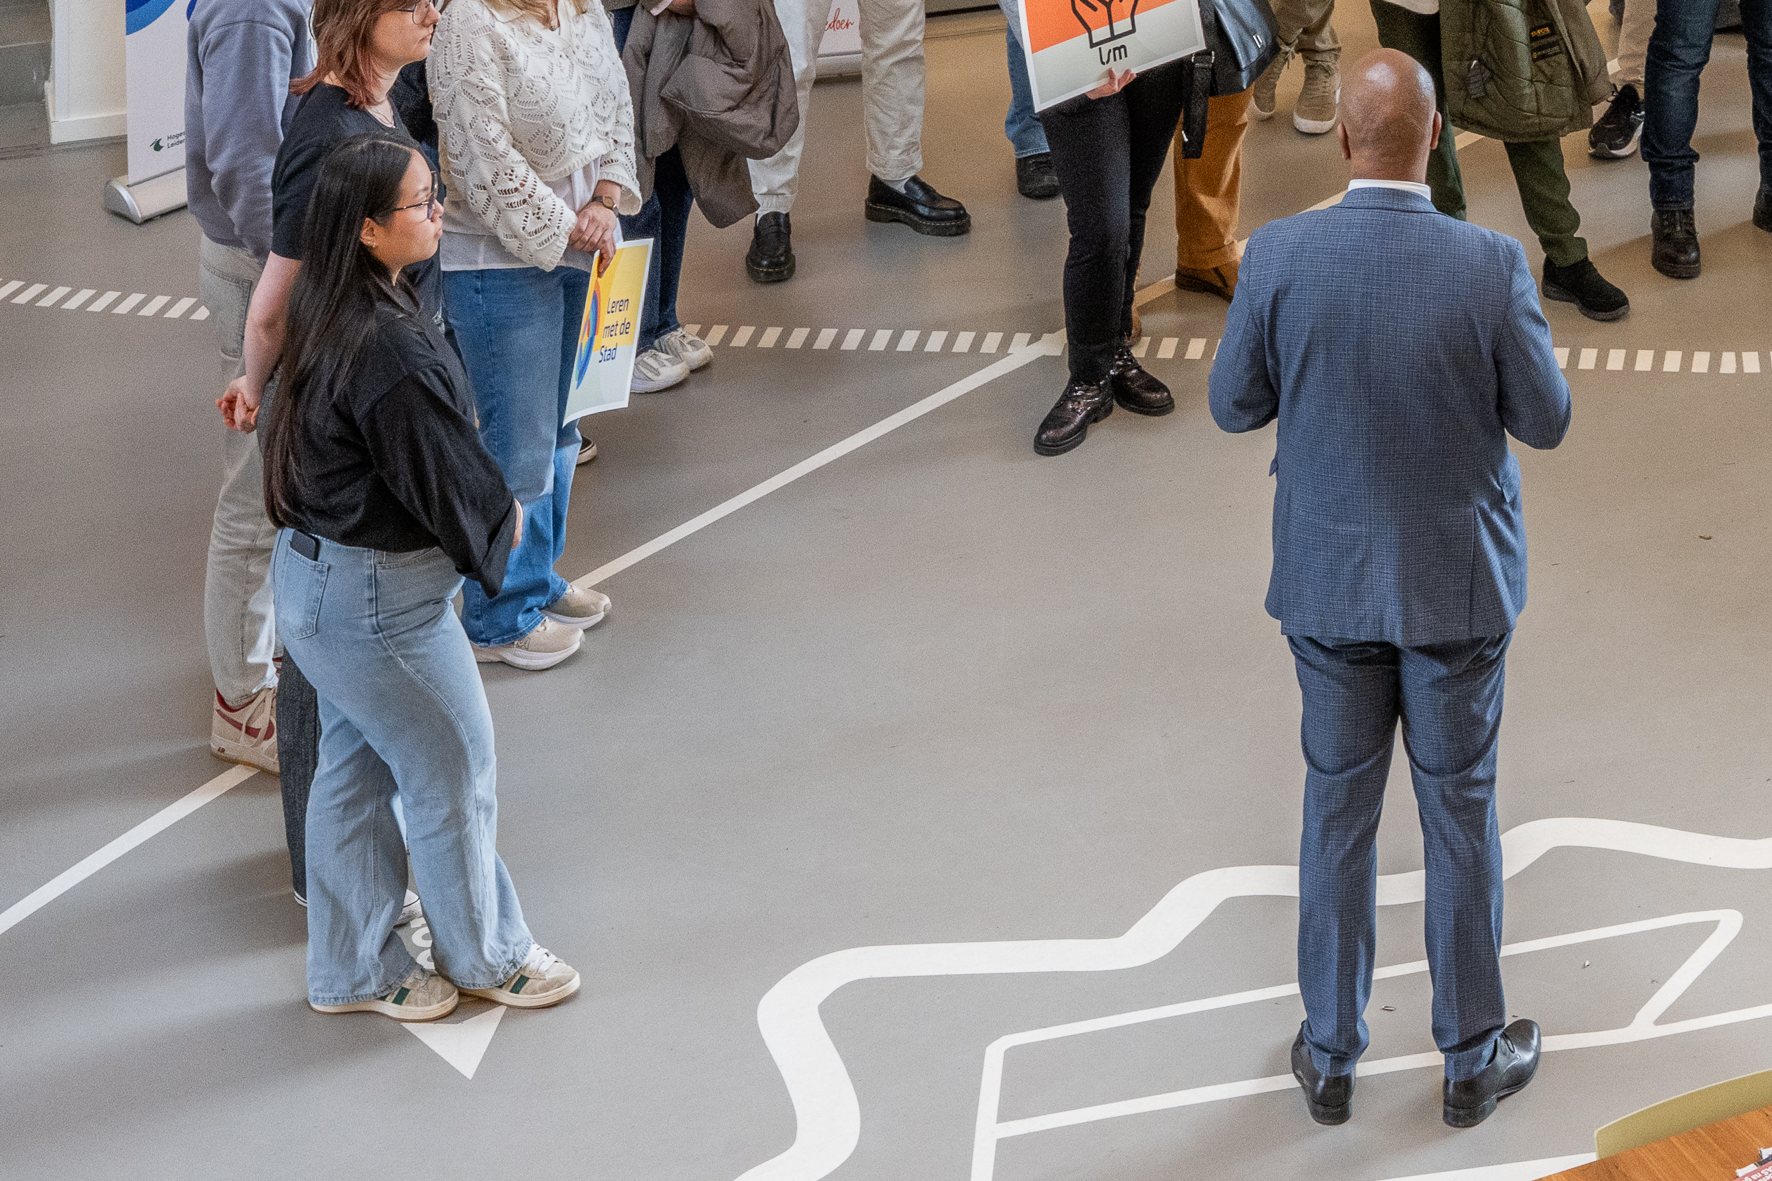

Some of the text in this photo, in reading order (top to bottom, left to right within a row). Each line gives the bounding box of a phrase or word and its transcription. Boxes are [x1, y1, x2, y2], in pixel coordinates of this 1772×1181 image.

[607, 298, 629, 314] Leren
[602, 320, 631, 339] met de
[599, 345, 617, 363] Stad
